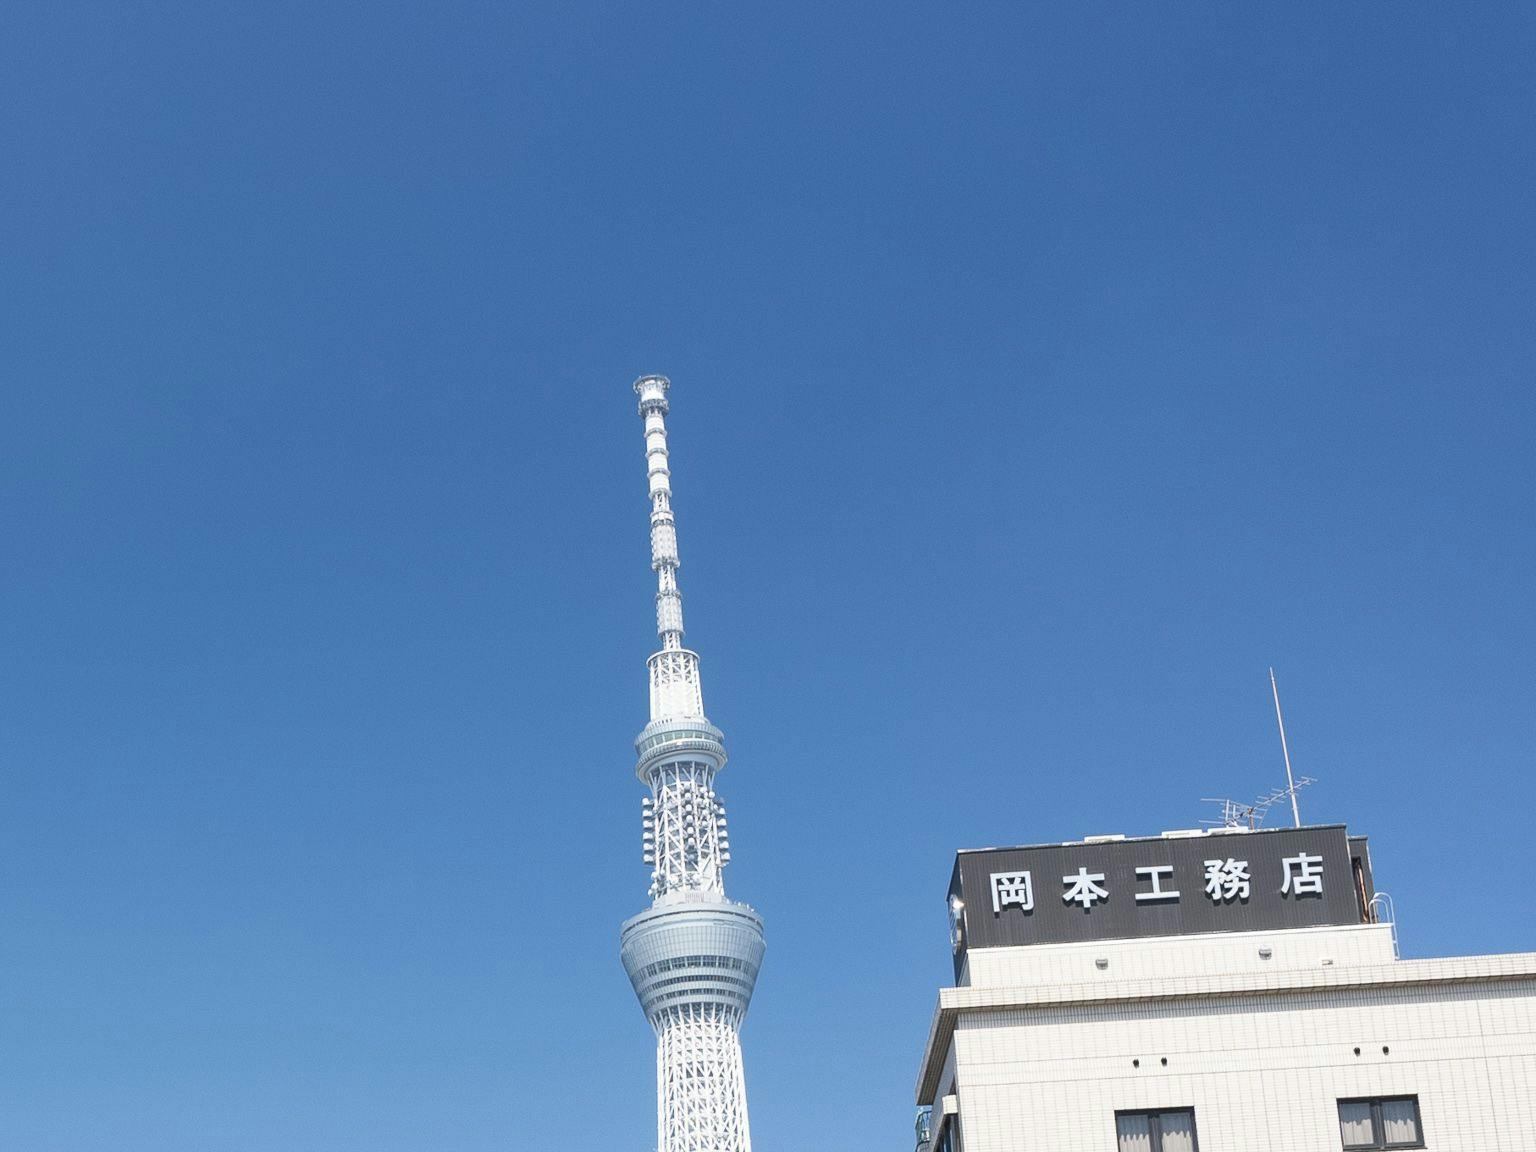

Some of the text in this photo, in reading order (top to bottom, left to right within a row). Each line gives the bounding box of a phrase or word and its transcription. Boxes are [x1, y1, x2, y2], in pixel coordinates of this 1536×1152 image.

[990, 852, 1325, 914] 岡本工務店
